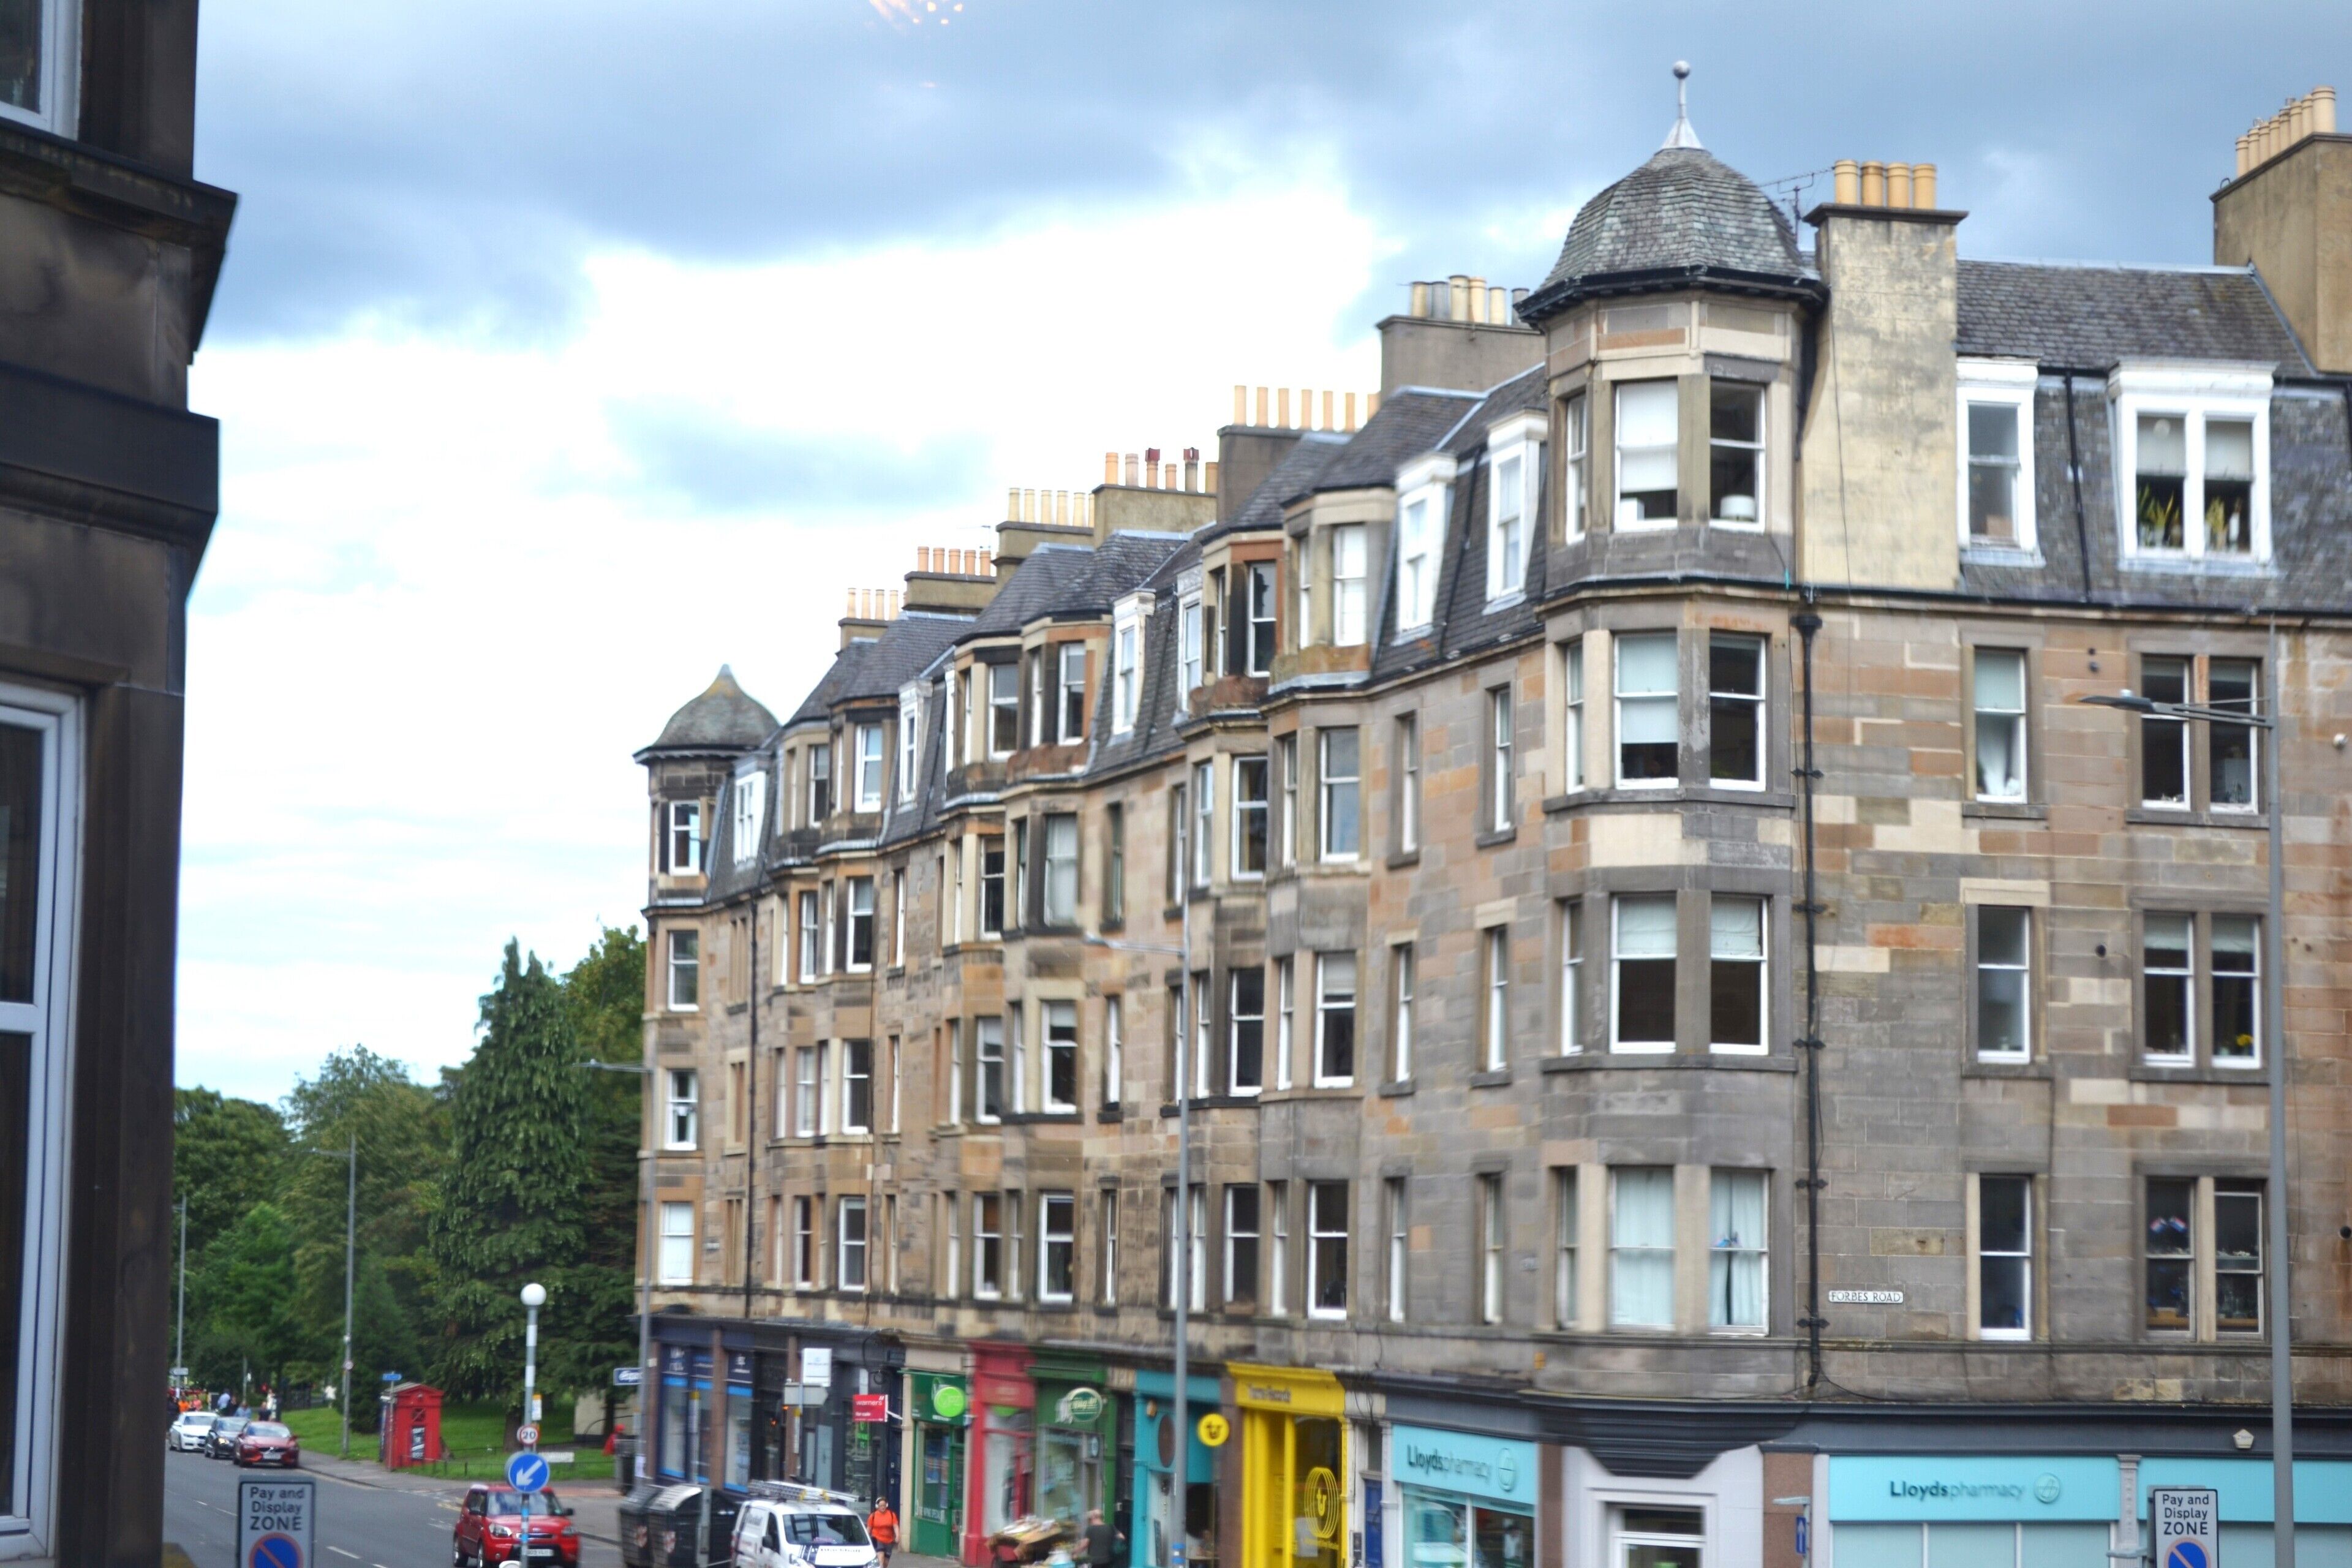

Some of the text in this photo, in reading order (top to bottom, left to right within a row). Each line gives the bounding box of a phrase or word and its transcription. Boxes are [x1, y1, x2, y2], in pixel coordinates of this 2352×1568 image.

[1831, 1292, 1901, 1302] FORBES ROAD
[250, 1487, 304, 1501] Pay and
[1890, 1480, 2024, 1501] Lloydspharmacy
[2163, 1494, 2209, 1507] Pay and
[252, 1501, 303, 1515] Display
[2165, 1507, 2207, 1520] Display
[250, 1516, 302, 1531] ZONE
[2163, 1521, 2208, 1535] ZONE
